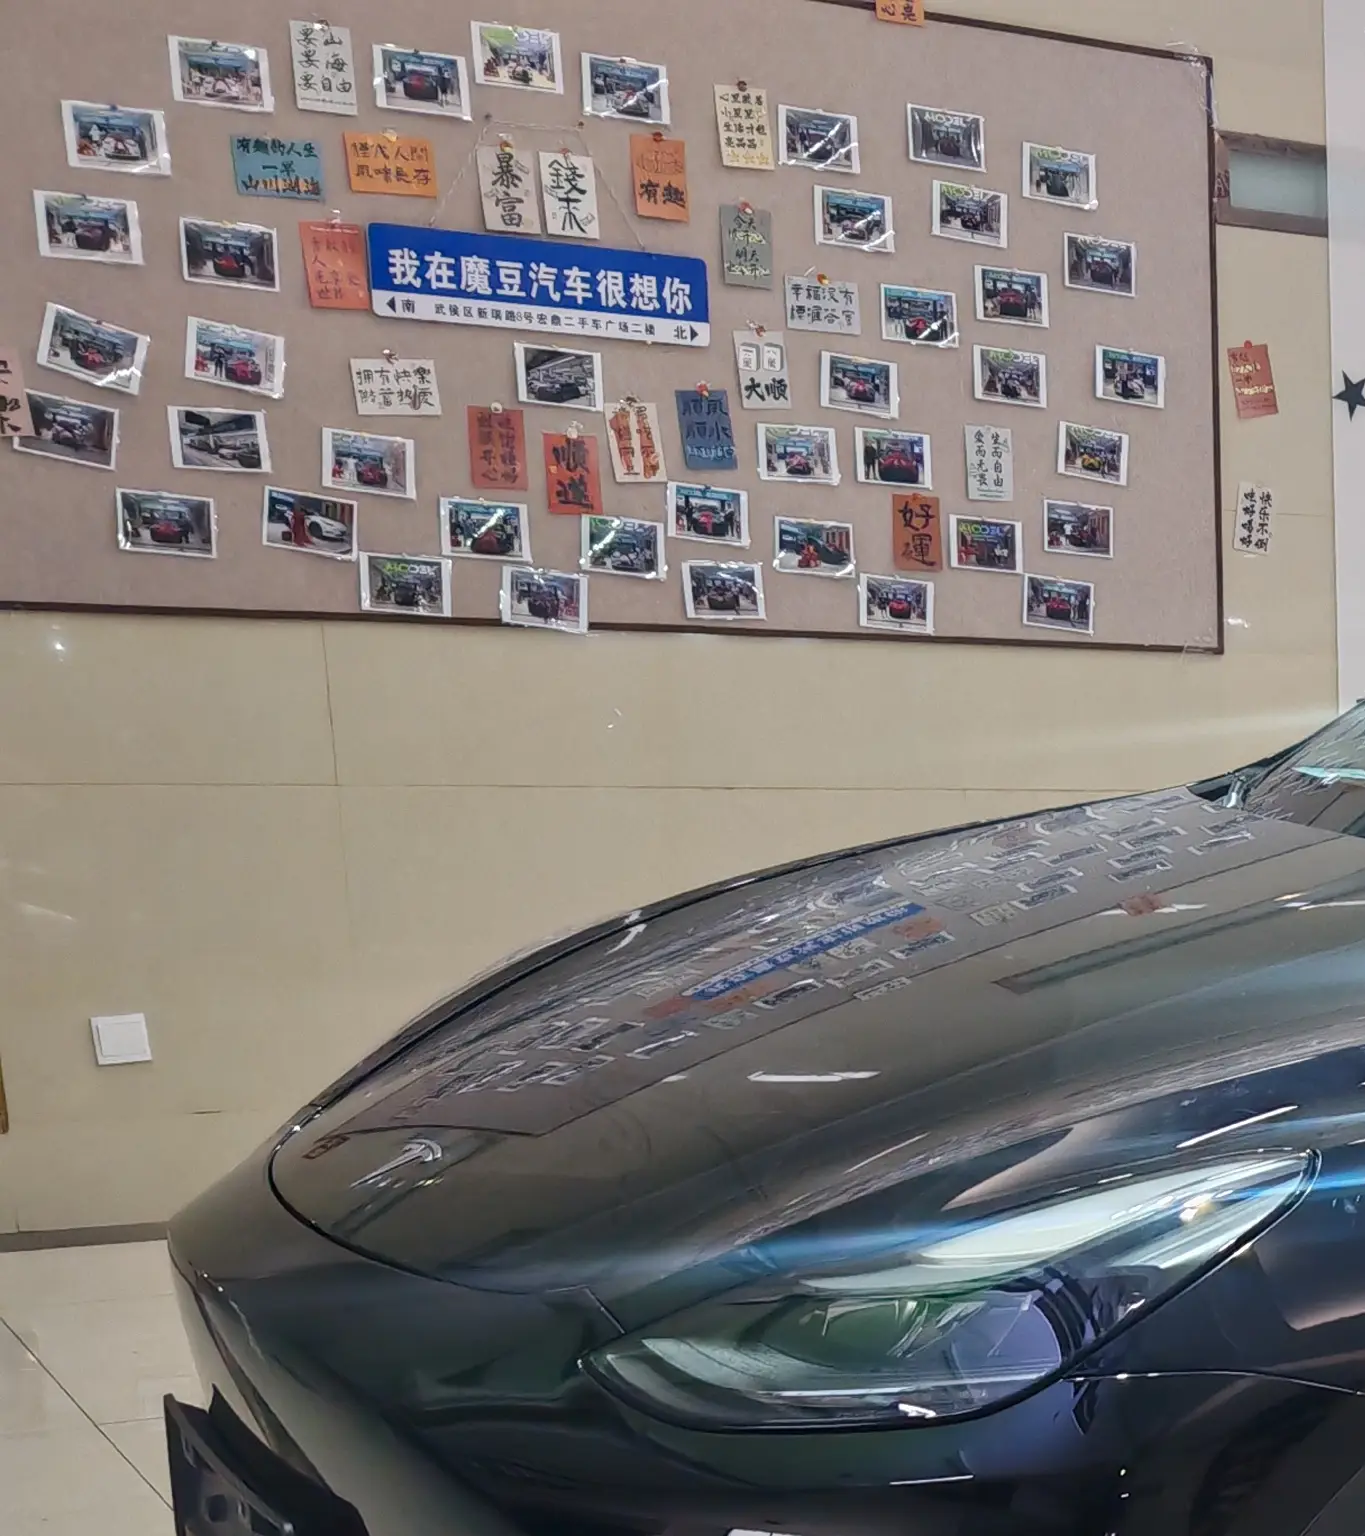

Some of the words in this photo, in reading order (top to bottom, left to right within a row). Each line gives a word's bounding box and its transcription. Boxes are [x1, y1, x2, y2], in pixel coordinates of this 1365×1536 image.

[492, 151, 524, 228] 暴富
[388, 247, 693, 315] 我在魔豆汽车很想你
[402, 299, 416, 314] 南
[673, 325, 688, 341] 北
